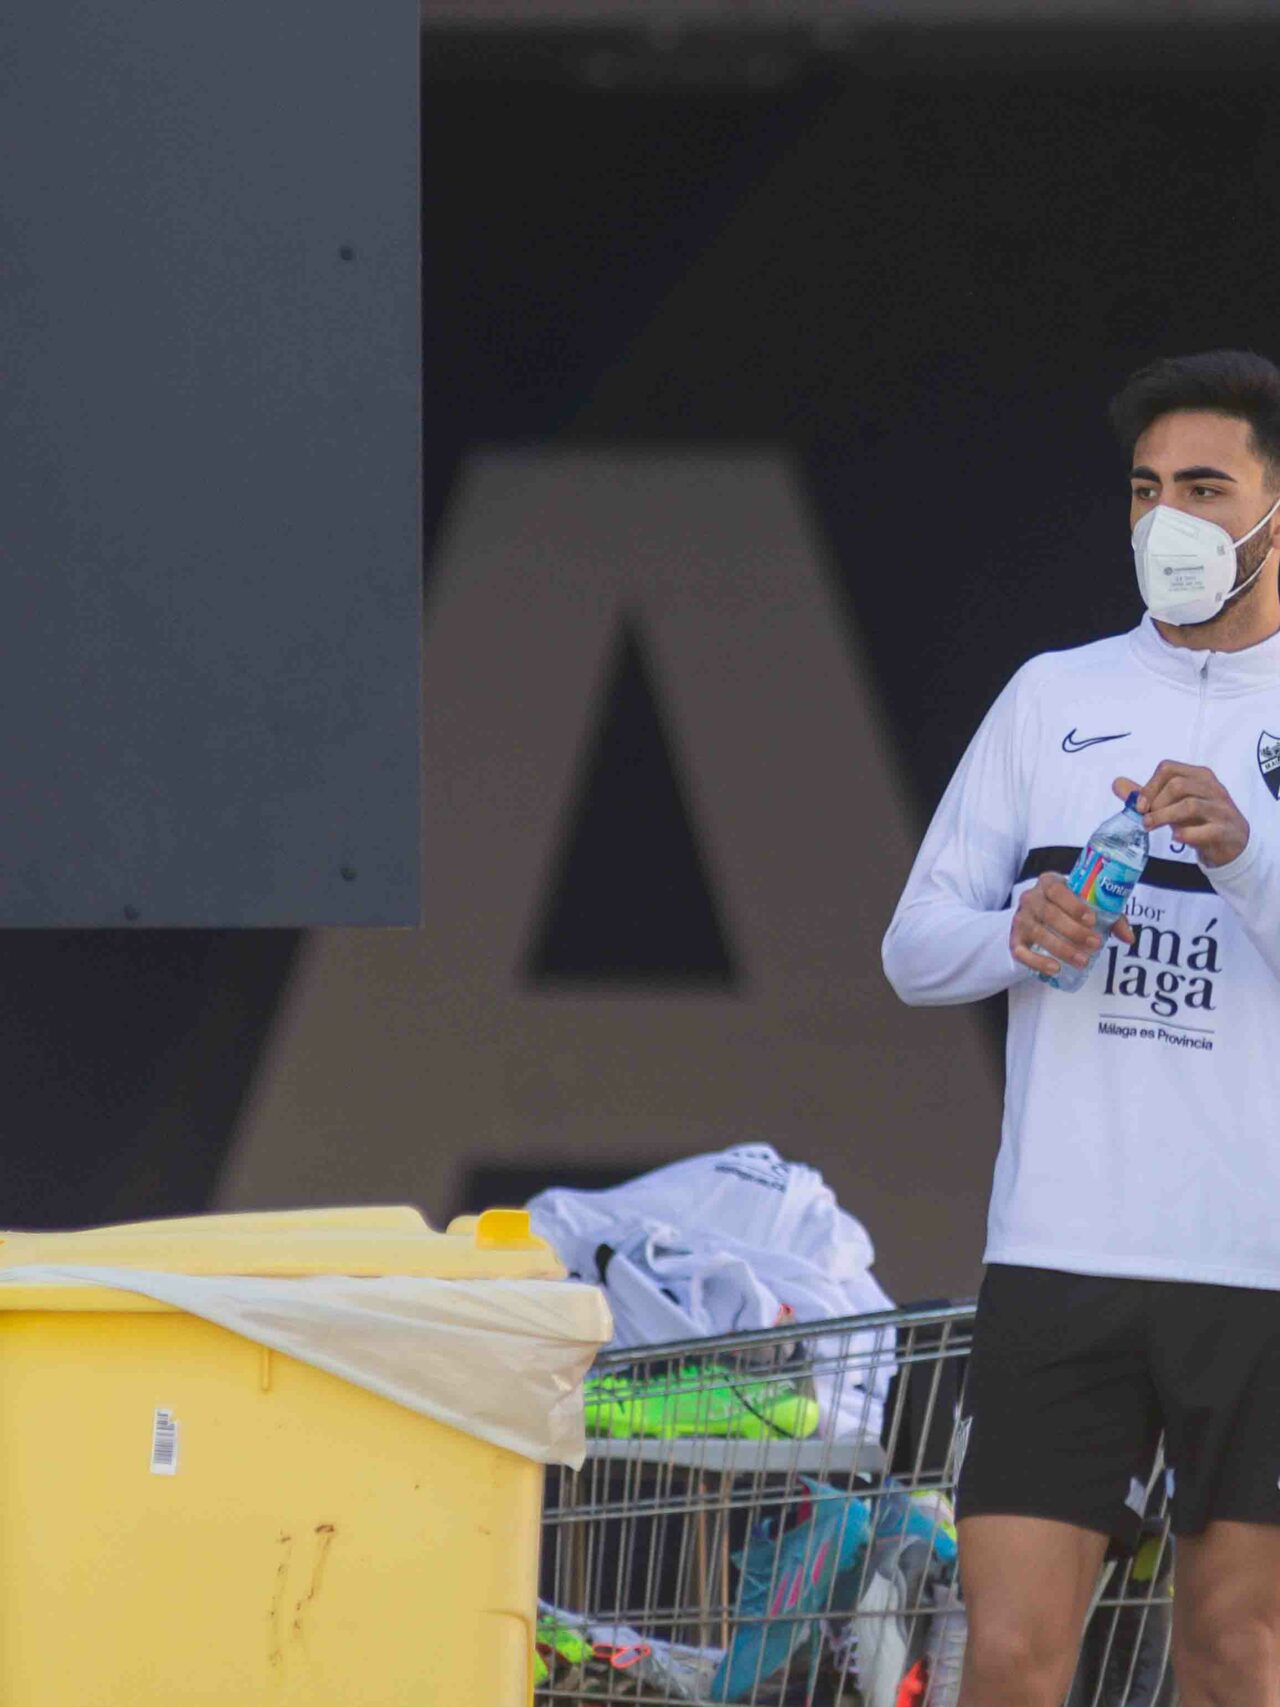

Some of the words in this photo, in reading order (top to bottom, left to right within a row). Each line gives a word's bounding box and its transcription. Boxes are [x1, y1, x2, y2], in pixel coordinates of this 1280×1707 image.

[1123, 896, 1165, 922] bor
[1125, 917, 1222, 973] má
[1103, 945, 1216, 1017] laga
[1098, 1021, 1137, 1039] Málaga
[1139, 1027, 1155, 1040] es
[1157, 1028, 1213, 1051] Provincia
